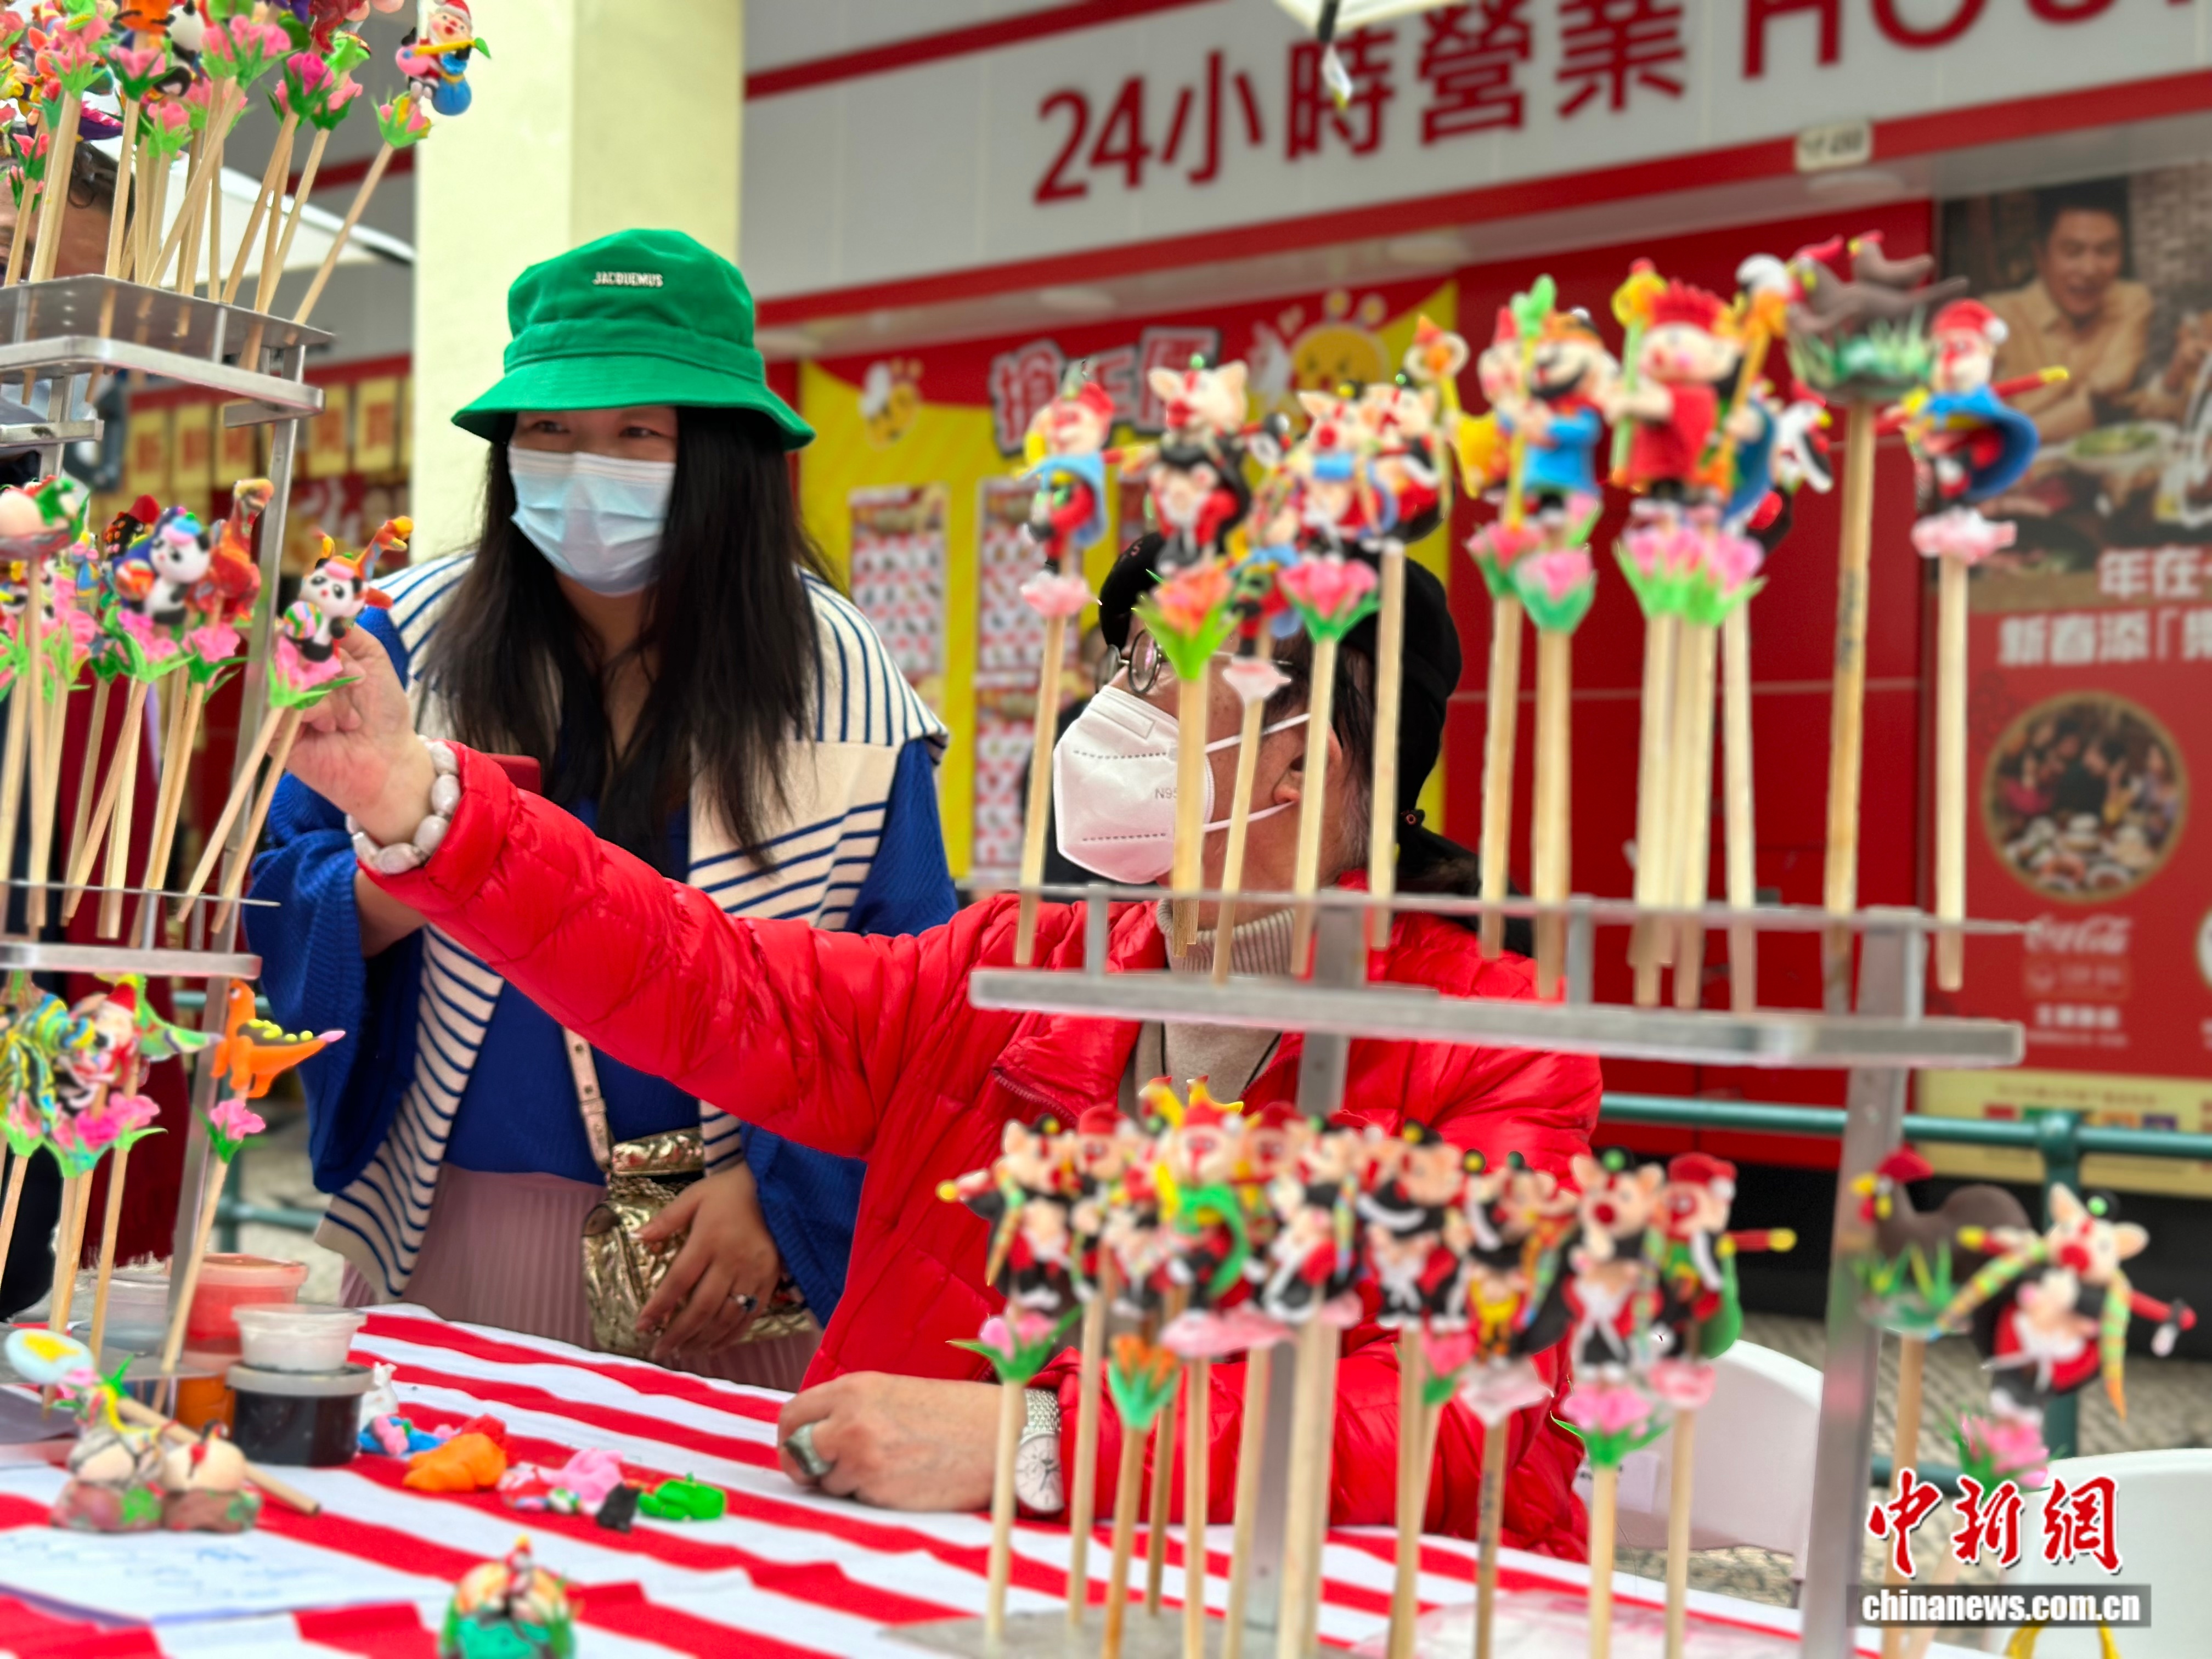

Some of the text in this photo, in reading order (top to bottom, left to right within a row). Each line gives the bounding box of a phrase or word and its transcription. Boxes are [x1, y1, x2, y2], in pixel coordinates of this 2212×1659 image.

[1032, 0, 1686, 207] 24小時營業
[592, 271, 663, 287] JACQUEMUS
[2100, 549, 2212, 600] 年在
